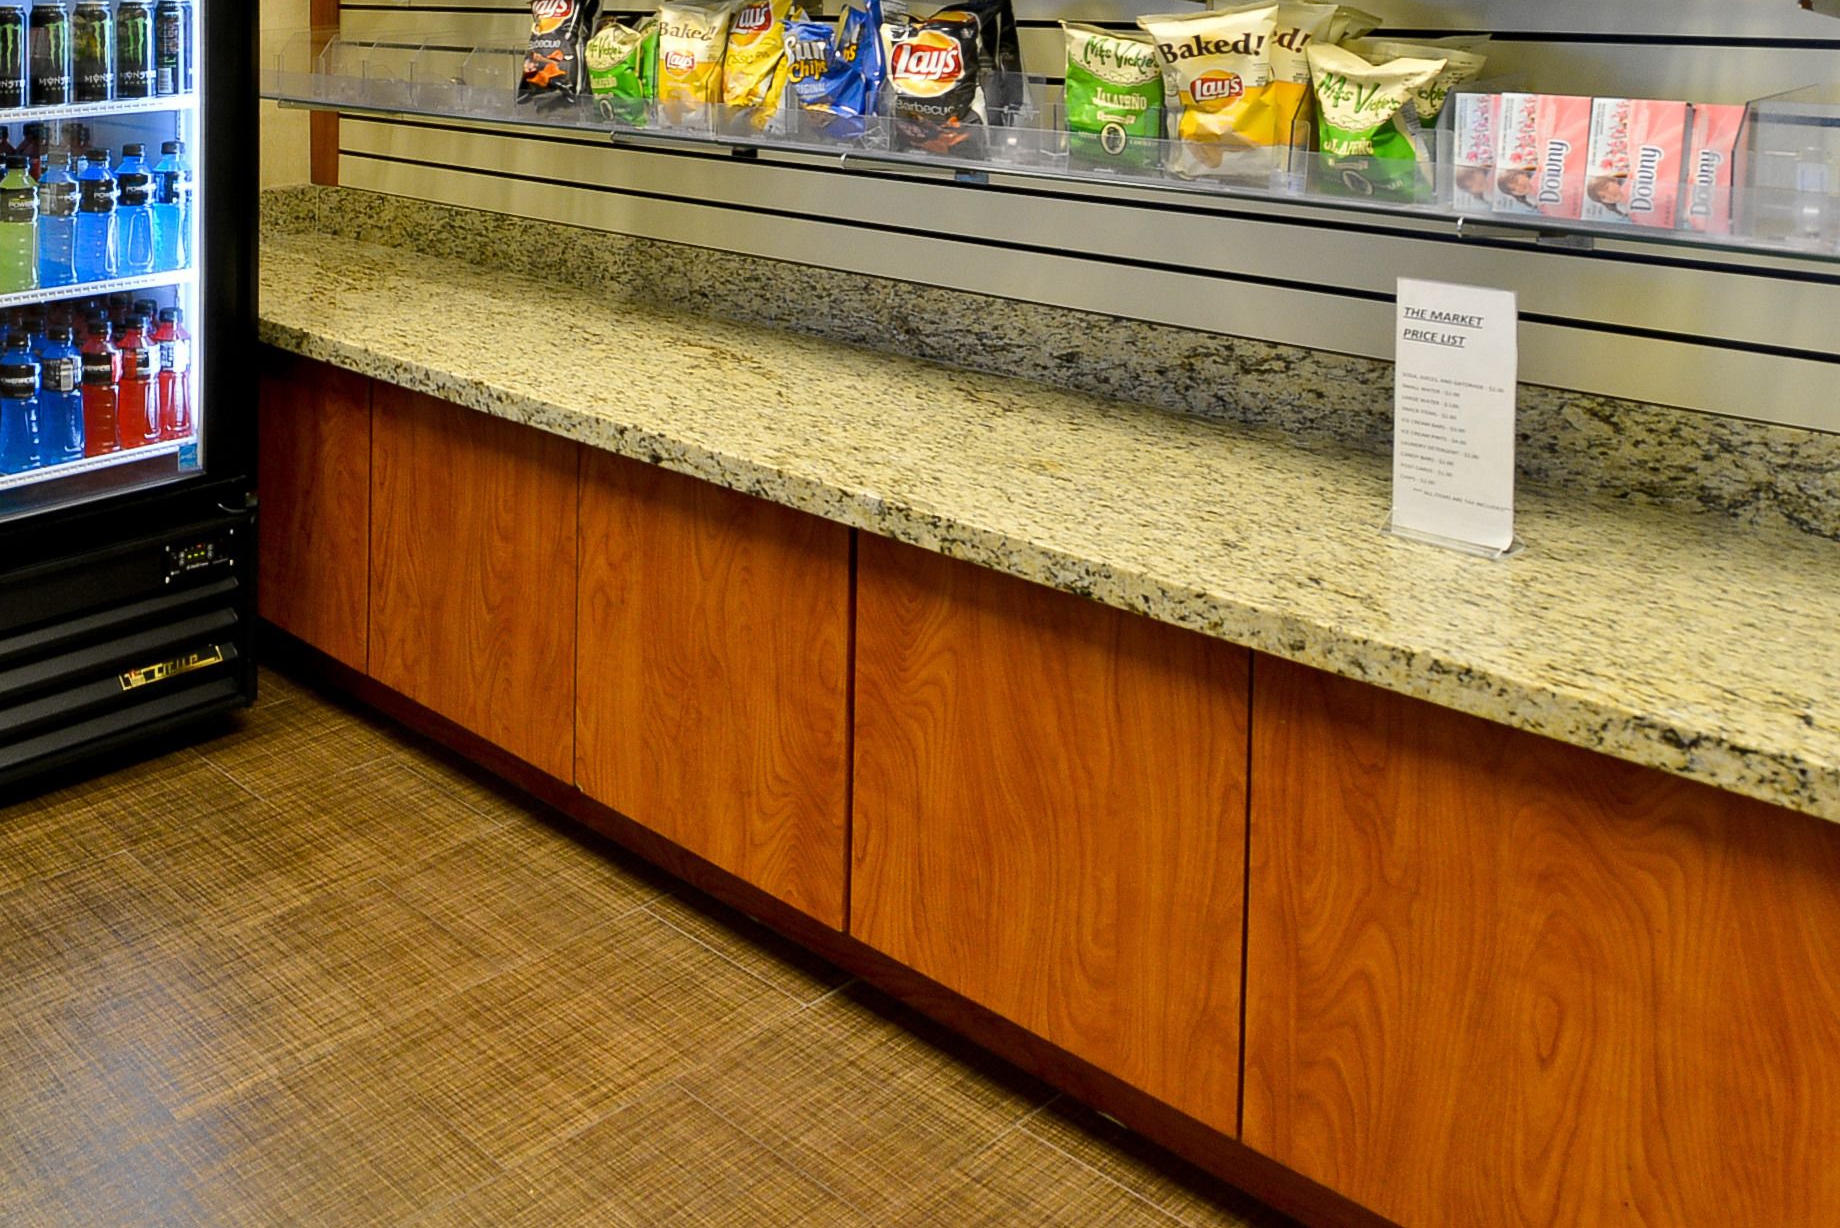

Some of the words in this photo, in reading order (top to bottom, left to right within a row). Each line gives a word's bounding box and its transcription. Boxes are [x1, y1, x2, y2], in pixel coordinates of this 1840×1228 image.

[894, 42, 959, 80] Lay's
[1158, 32, 1266, 64] Baked!
[1194, 75, 1243, 100] Lay's
[1538, 139, 1570, 205] Downy
[1630, 144, 1663, 214] Downy
[1690, 149, 1724, 218] Downy
[1404, 306, 1428, 319] THE
[1431, 310, 1484, 328] MARKET
[1404, 328, 1439, 343] PRICE
[1441, 333, 1466, 347] LIST
